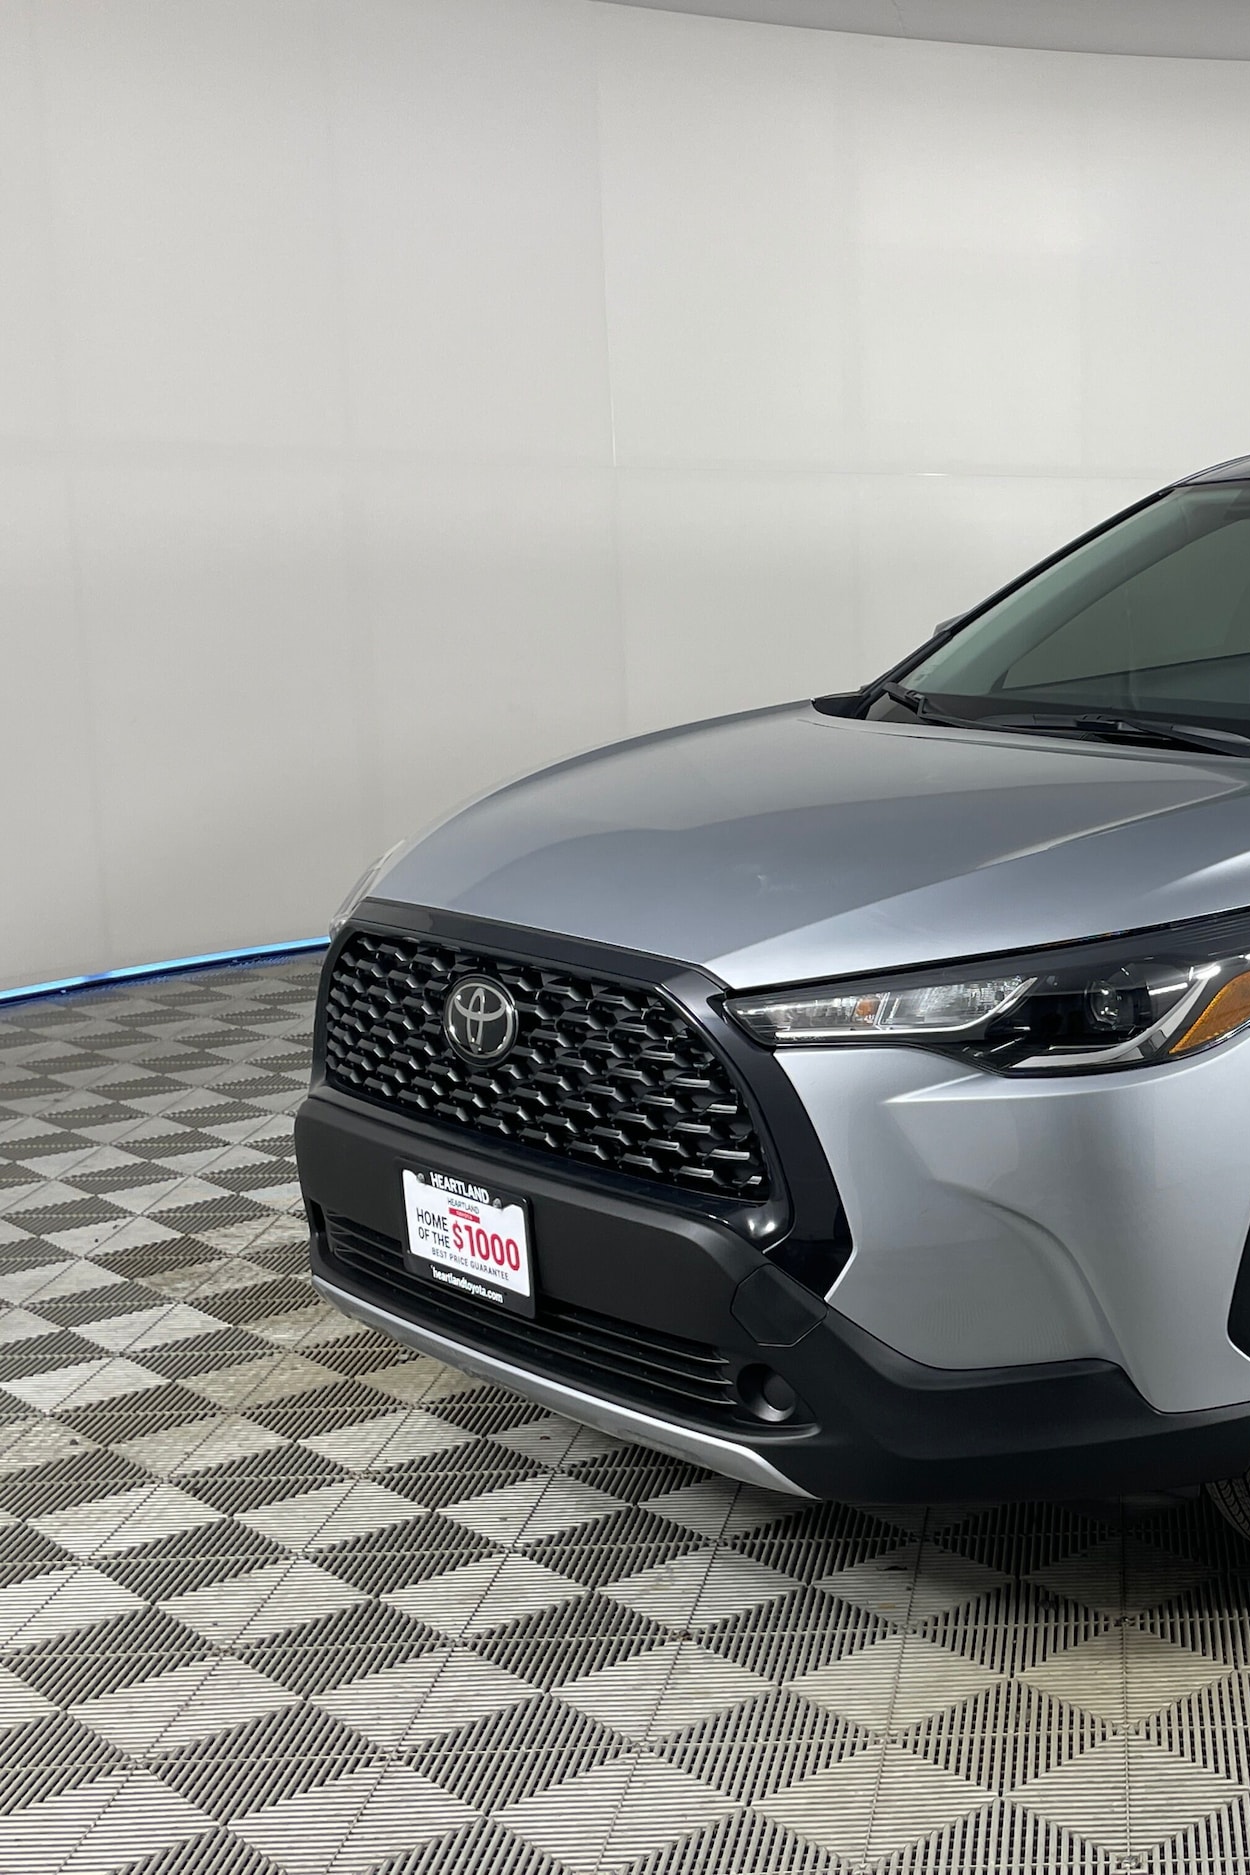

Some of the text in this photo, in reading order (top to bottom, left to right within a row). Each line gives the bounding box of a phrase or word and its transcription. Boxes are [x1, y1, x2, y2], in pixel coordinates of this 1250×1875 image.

[430, 1172, 490, 1204] HEARTLAND
[416, 1208, 449, 1232] HOME
[447, 1198, 480, 1214] HEARTLAND
[418, 1227, 450, 1249] OF THE
[452, 1220, 520, 1271] $1000
[431, 1247, 509, 1281] BEST PRICE GUARANTEE
[432, 1266, 503, 1303] heartlandtoyota.com
